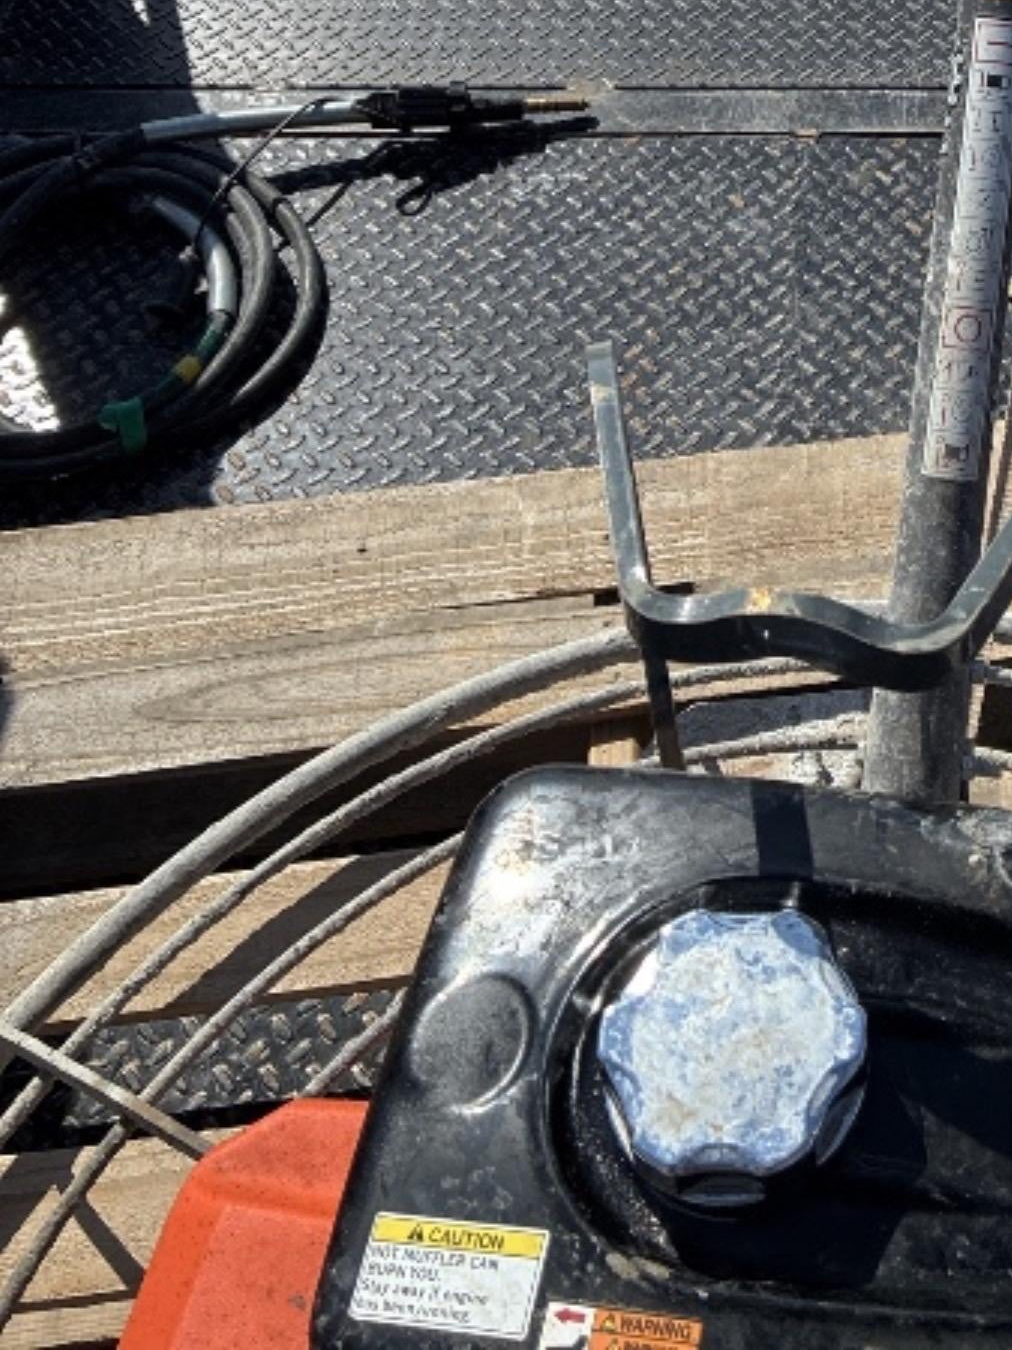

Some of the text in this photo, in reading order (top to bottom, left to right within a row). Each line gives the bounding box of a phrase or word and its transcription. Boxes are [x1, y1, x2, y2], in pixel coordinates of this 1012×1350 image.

[428, 1227, 505, 1250] CAUTION
[402, 1248, 465, 1267] MUFFLER
[620, 1314, 690, 1339] WARNING
